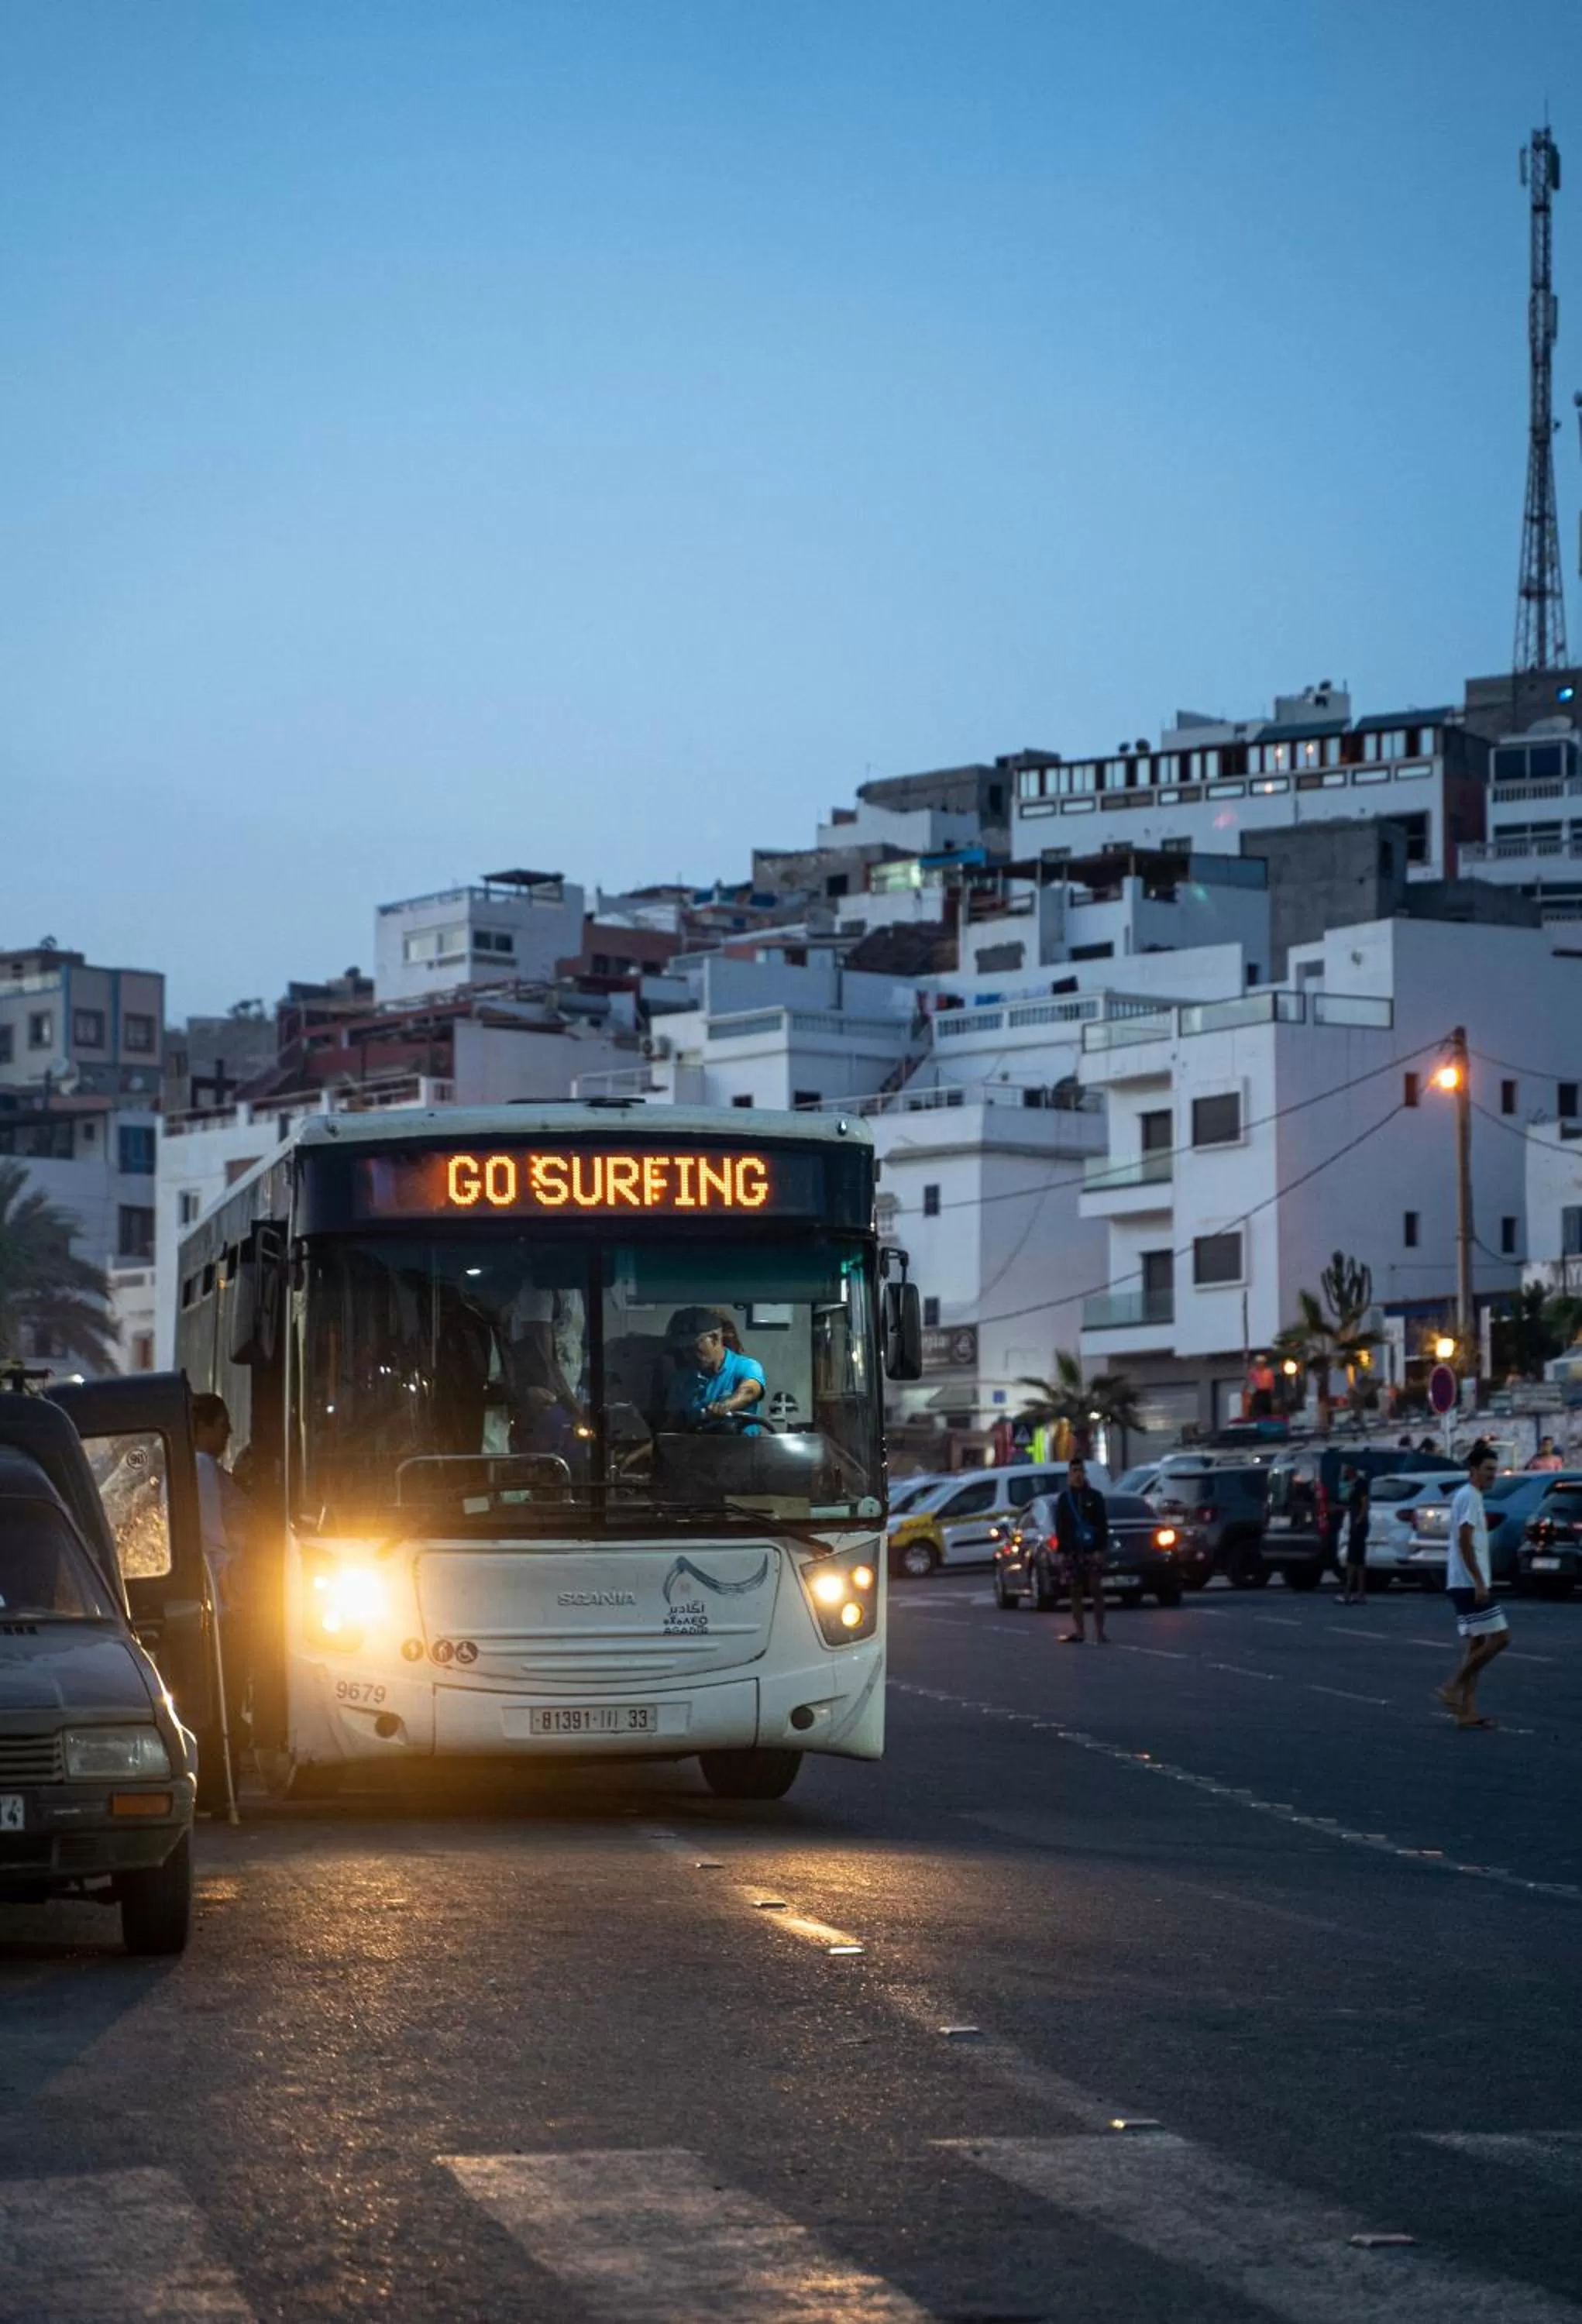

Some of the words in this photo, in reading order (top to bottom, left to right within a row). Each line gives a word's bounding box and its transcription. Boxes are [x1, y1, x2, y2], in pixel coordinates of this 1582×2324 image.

[449, 1155, 516, 1205] GO
[532, 1155, 769, 1205] SURFING
[557, 1591, 636, 1606] SCANIA
[335, 1681, 386, 1704] 9679
[542, 1710, 590, 1730] 81391
[628, 1710, 648, 1728] 33
